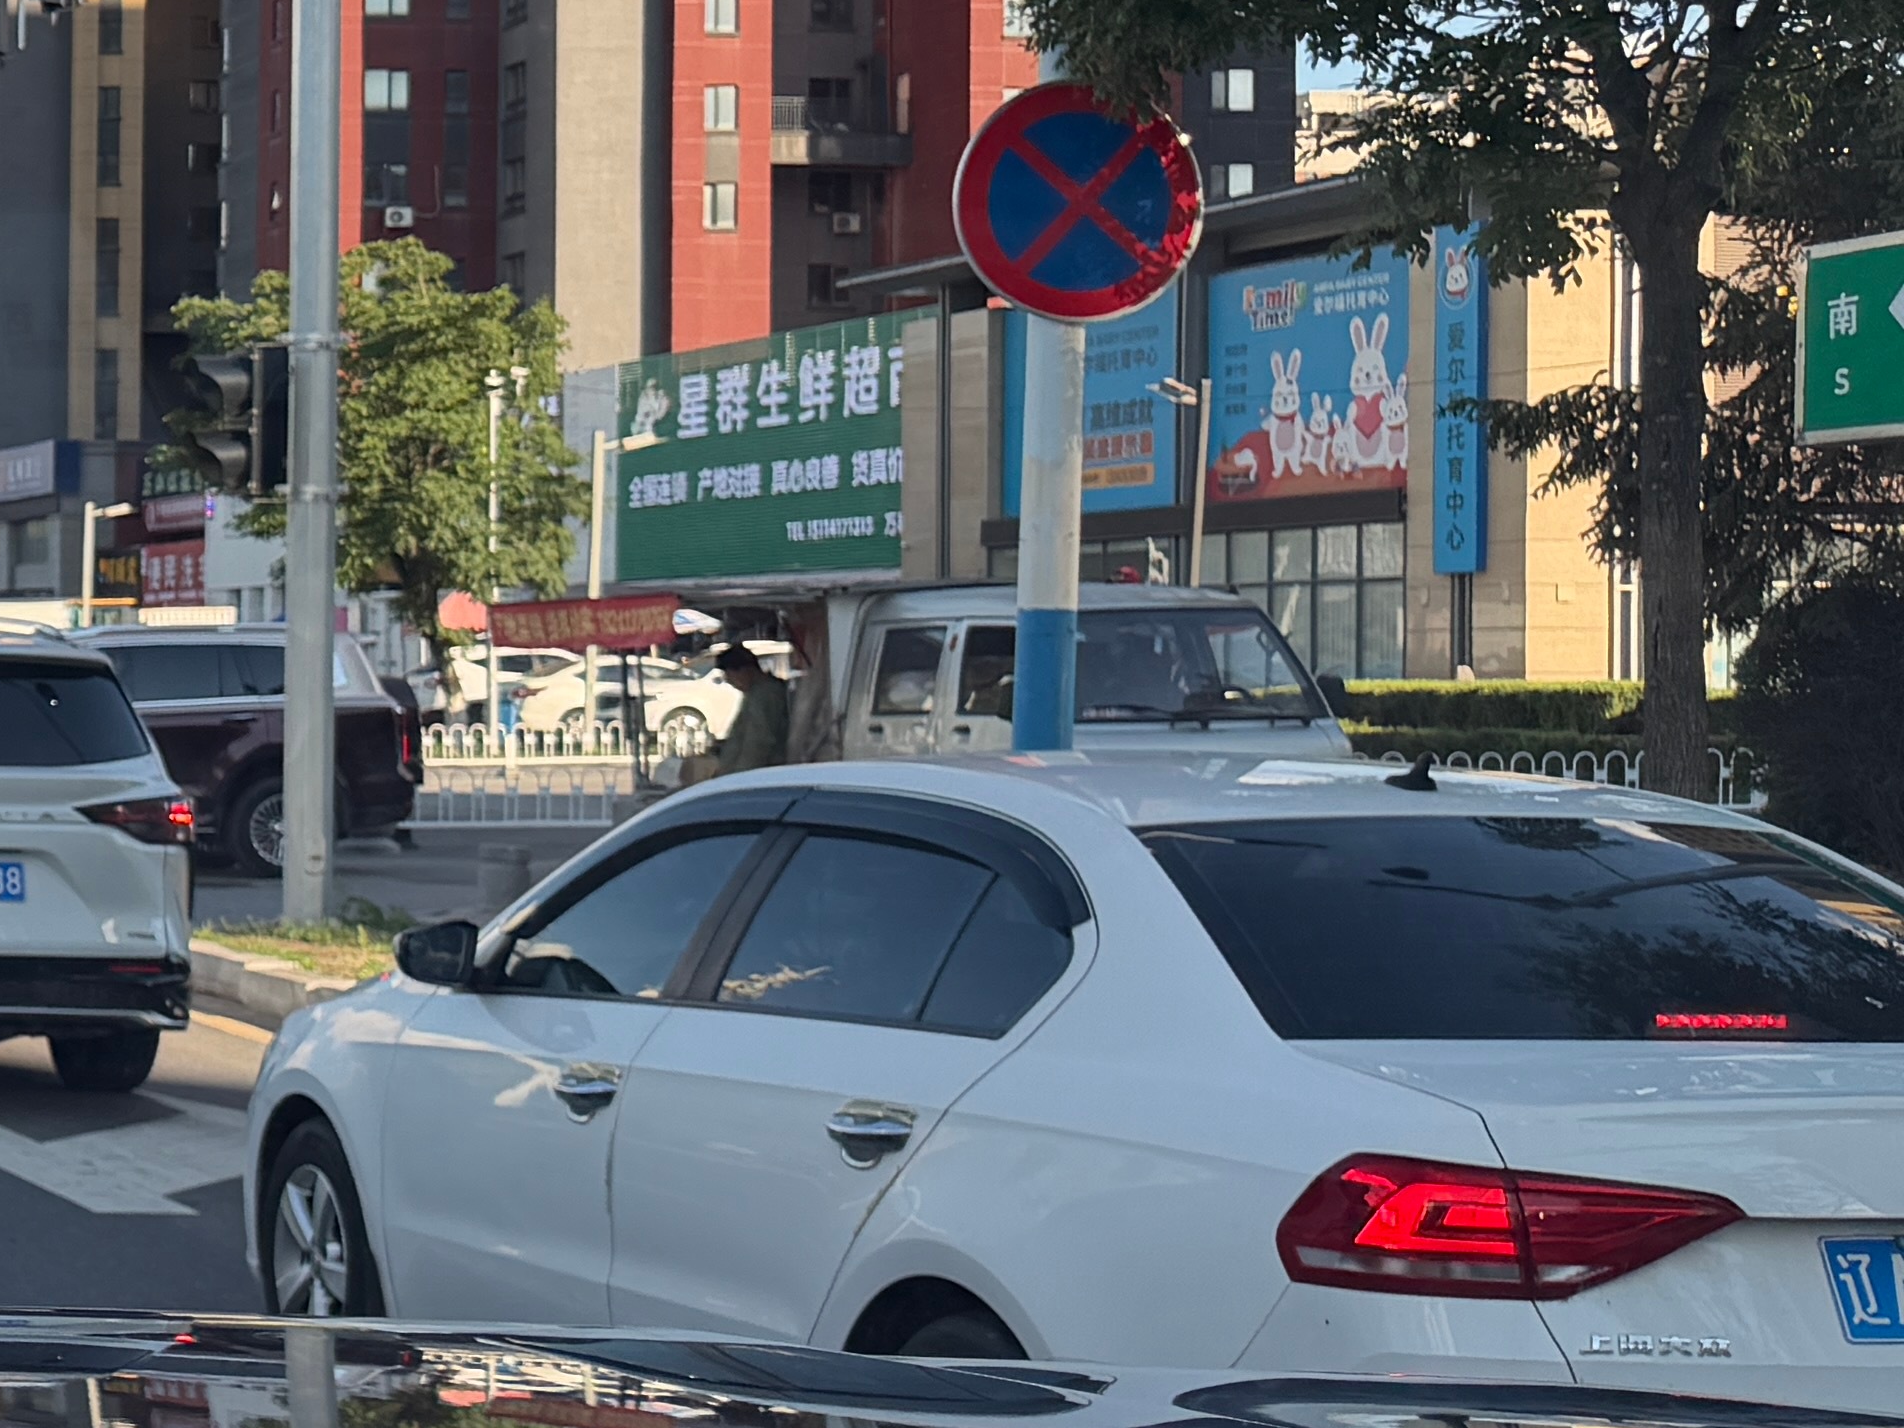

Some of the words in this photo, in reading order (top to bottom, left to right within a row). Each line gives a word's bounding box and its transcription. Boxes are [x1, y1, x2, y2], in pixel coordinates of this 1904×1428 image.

[1243, 279, 1307, 312] Family
[1827, 292, 1859, 340] 南
[1833, 367, 1851, 396] S
[1837, 1253, 1904, 1325] 辽
[1579, 1333, 1732, 1358] 上海大众
